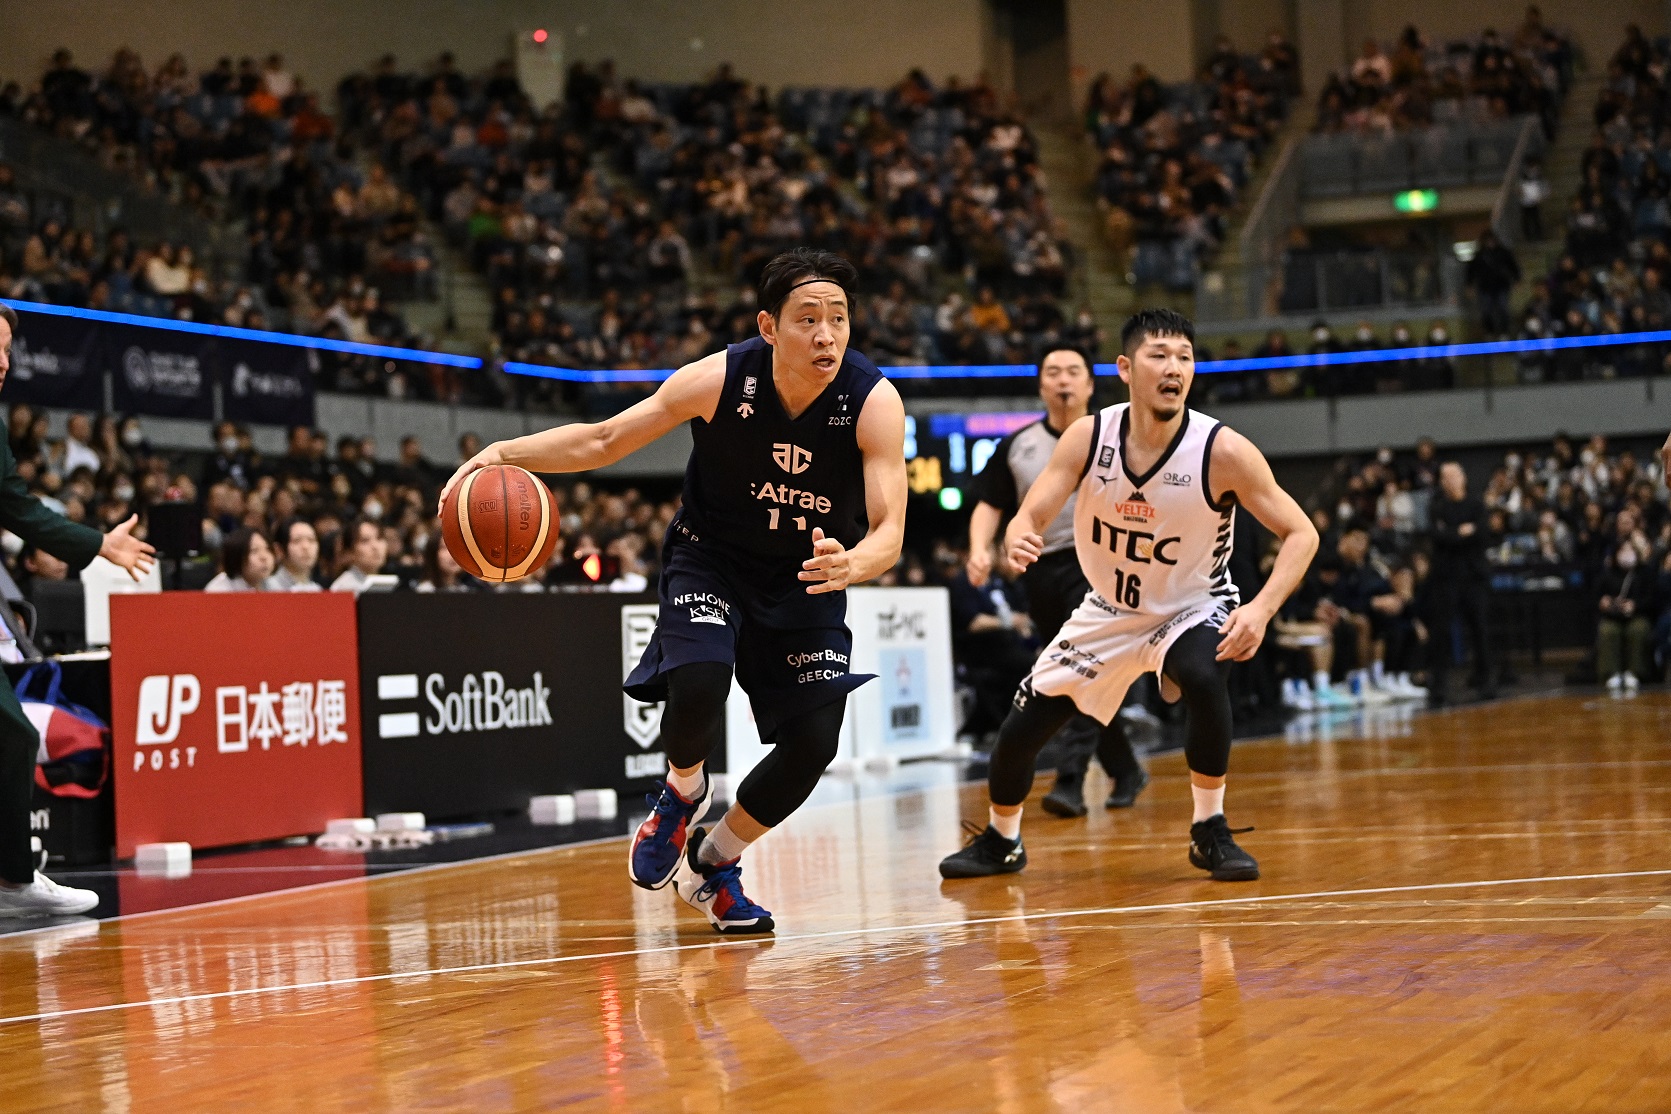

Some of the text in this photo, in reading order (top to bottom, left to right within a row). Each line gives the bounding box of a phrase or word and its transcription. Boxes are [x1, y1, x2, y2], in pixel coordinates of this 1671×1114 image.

[1115, 567, 1141, 609] 16
[216, 679, 348, 753] 日本郵便
[425, 671, 553, 735] SoftBank
[133, 746, 197, 772] POST
